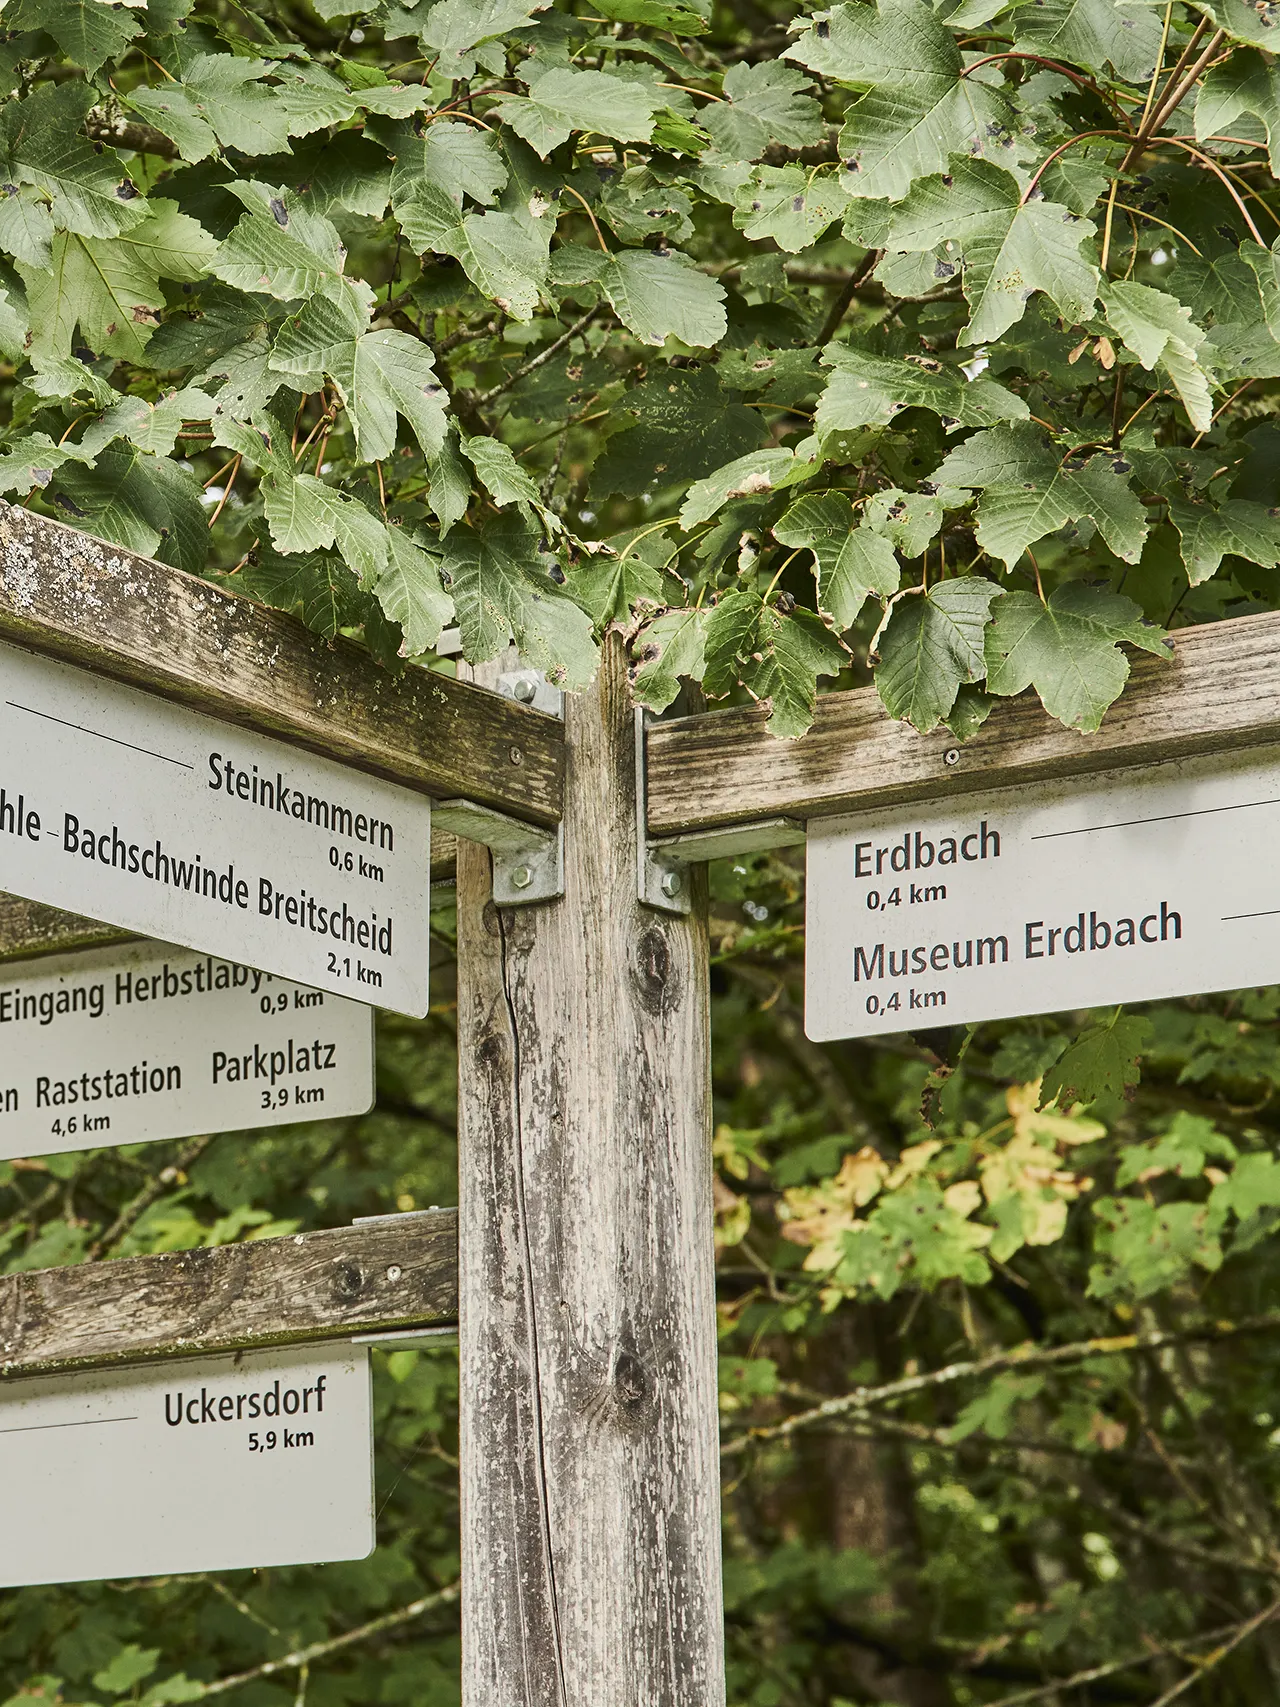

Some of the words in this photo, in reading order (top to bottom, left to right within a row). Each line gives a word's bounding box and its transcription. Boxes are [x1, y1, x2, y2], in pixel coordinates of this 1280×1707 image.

[209, 753, 393, 851] Steinkammern
[330, 847, 353, 871] 0,6
[359, 855, 383, 882] km
[855, 821, 1000, 878] Erdbach
[64, 813, 248, 908] Bachschwinde
[259, 878, 392, 956] Breitscheid
[867, 888, 901, 911] 0,4
[910, 884, 946, 903] km
[854, 936, 1008, 982] Museum
[1026, 902, 1181, 959] Erdbach
[328, 953, 350, 977] 2,1
[358, 960, 381, 987] km
[0, 985, 104, 1025] Eingang
[261, 993, 287, 1015] 0,9
[295, 990, 323, 1008] km
[866, 992, 901, 1016] 0,4
[910, 989, 945, 1009] km
[37, 1061, 180, 1107] Raststation
[213, 1039, 335, 1085] Parkplatz
[262, 1089, 288, 1110] 3,9
[296, 1086, 324, 1104] km
[52, 1117, 76, 1136] 4,6
[84, 1114, 109, 1131] km
[166, 1375, 326, 1426] Uckersdorf
[249, 1431, 276, 1452] 5,9
[284, 1429, 313, 1447] km
